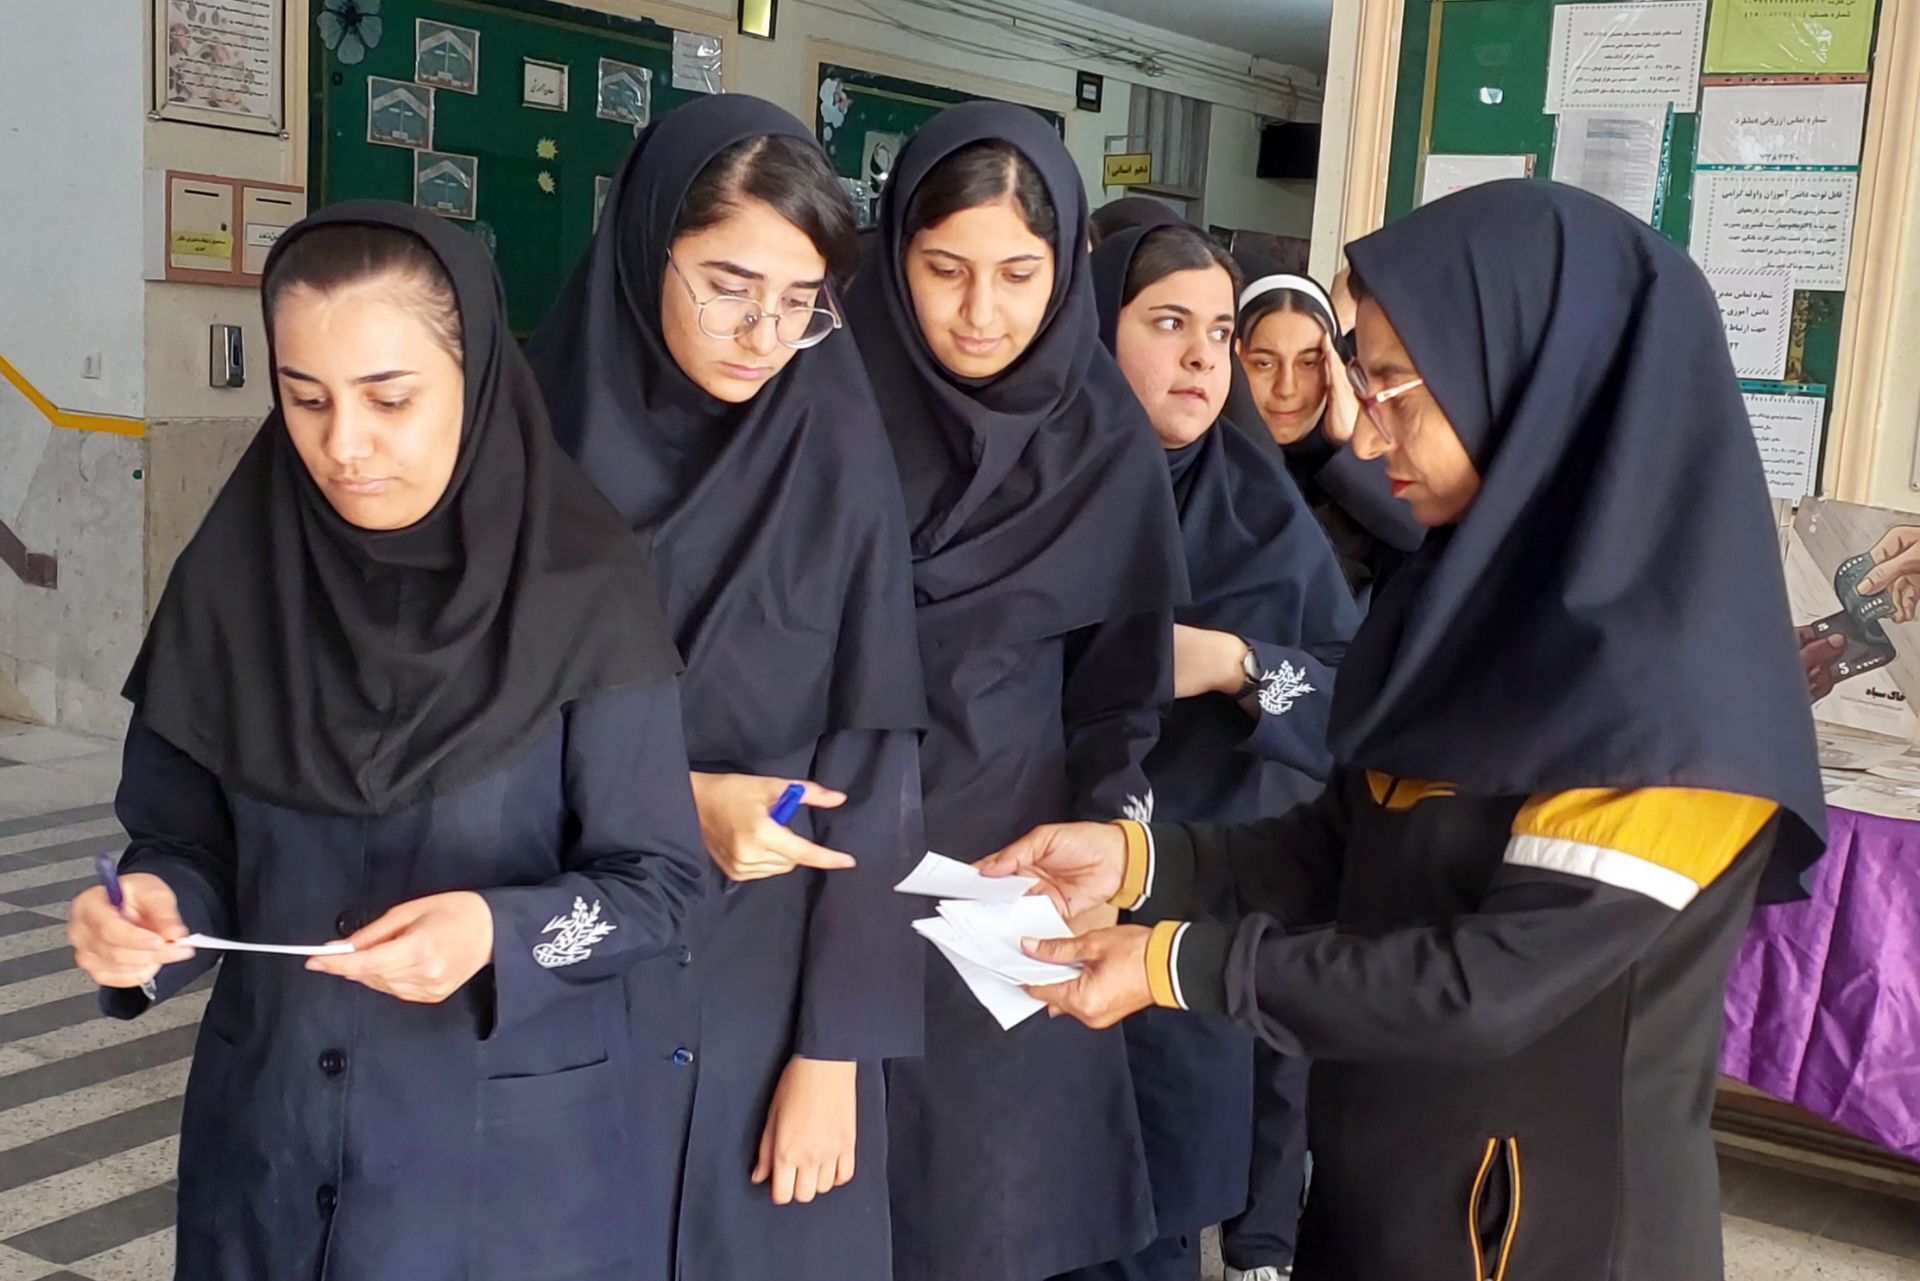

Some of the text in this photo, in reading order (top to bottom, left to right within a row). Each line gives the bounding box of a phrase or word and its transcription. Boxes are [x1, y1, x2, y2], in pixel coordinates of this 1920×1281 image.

[1764, 189, 1788, 200] آموزان
[1734, 289, 1752, 300] تماس
[1753, 290, 1773, 301] شماره
[1865, 686, 1907, 702] خاک سیاه
